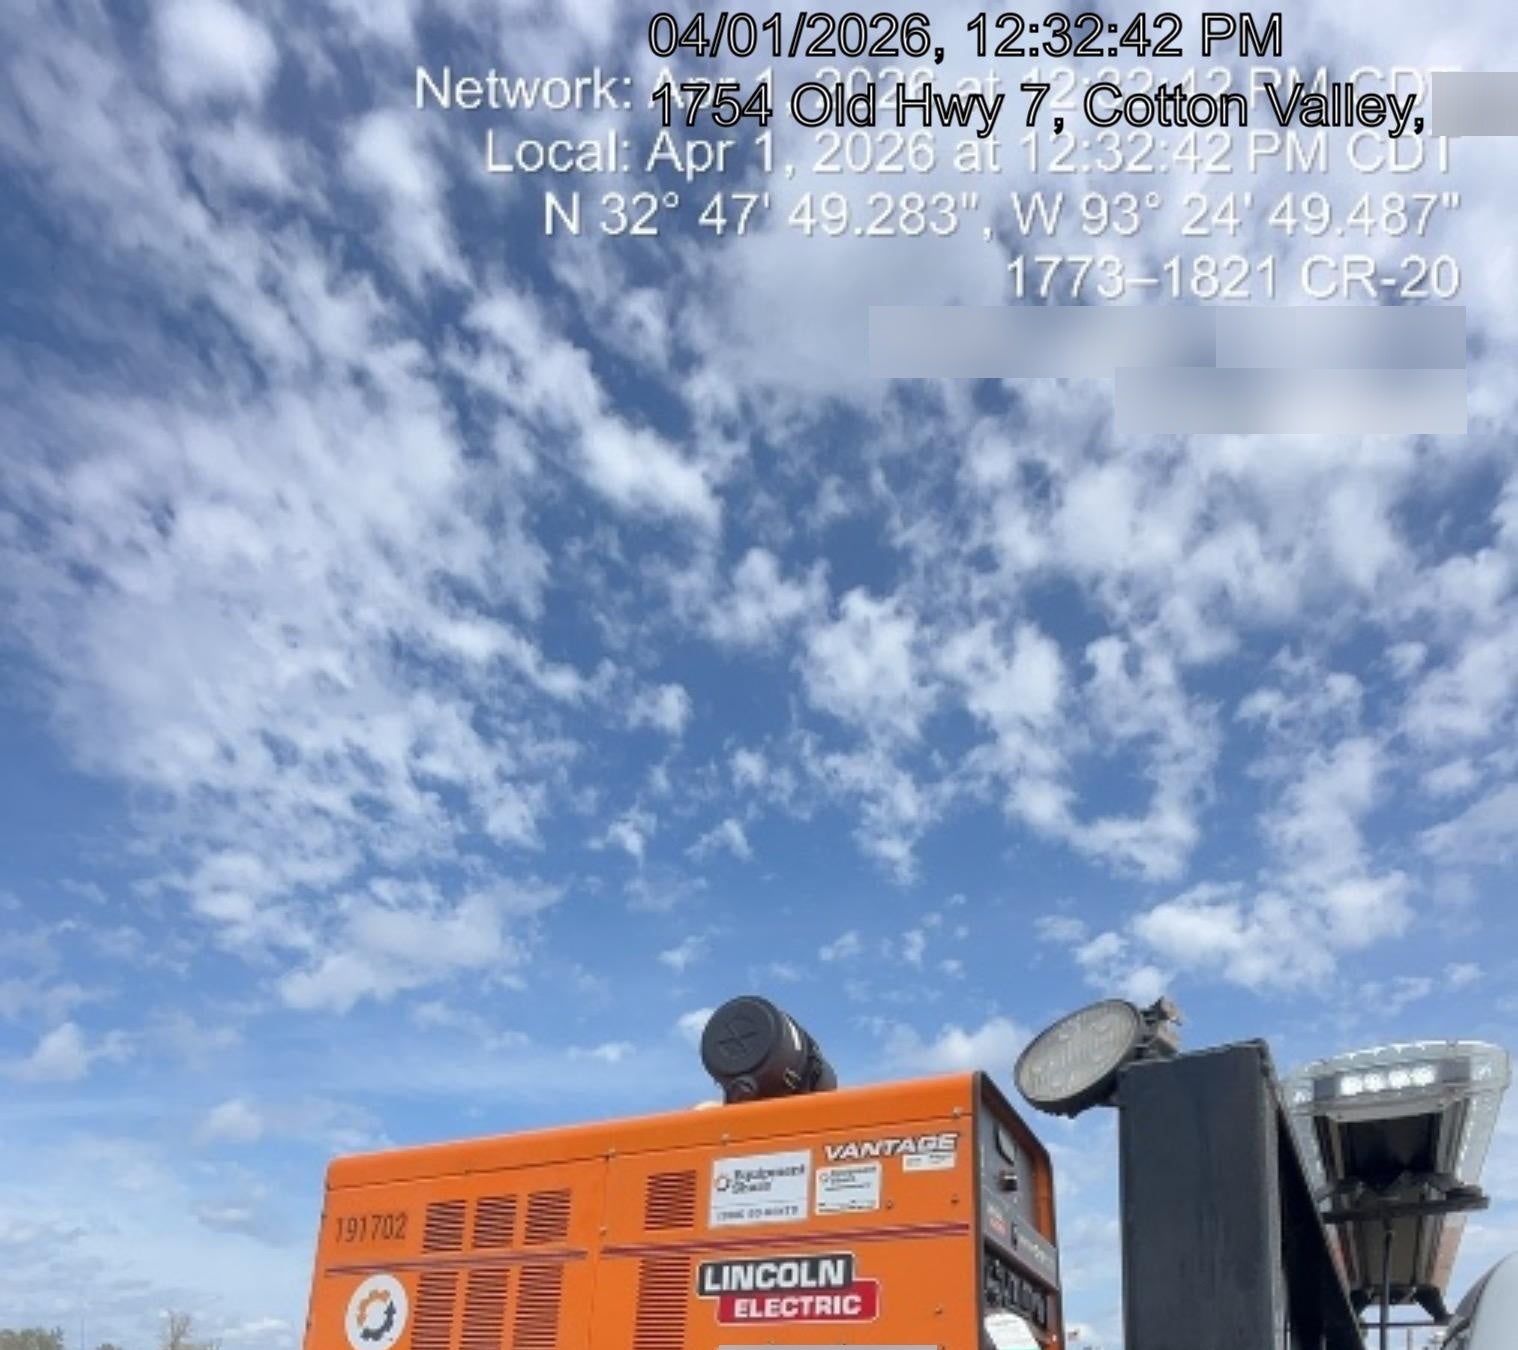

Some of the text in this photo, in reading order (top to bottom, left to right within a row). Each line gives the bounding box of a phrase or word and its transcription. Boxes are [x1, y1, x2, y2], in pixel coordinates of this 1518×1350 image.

[824, 1132, 960, 1161] VANTAGE
[334, 1211, 409, 1243] 191702
[703, 1258, 845, 1292] LINCOLN
[733, 1293, 863, 1319] ELECTRIC
